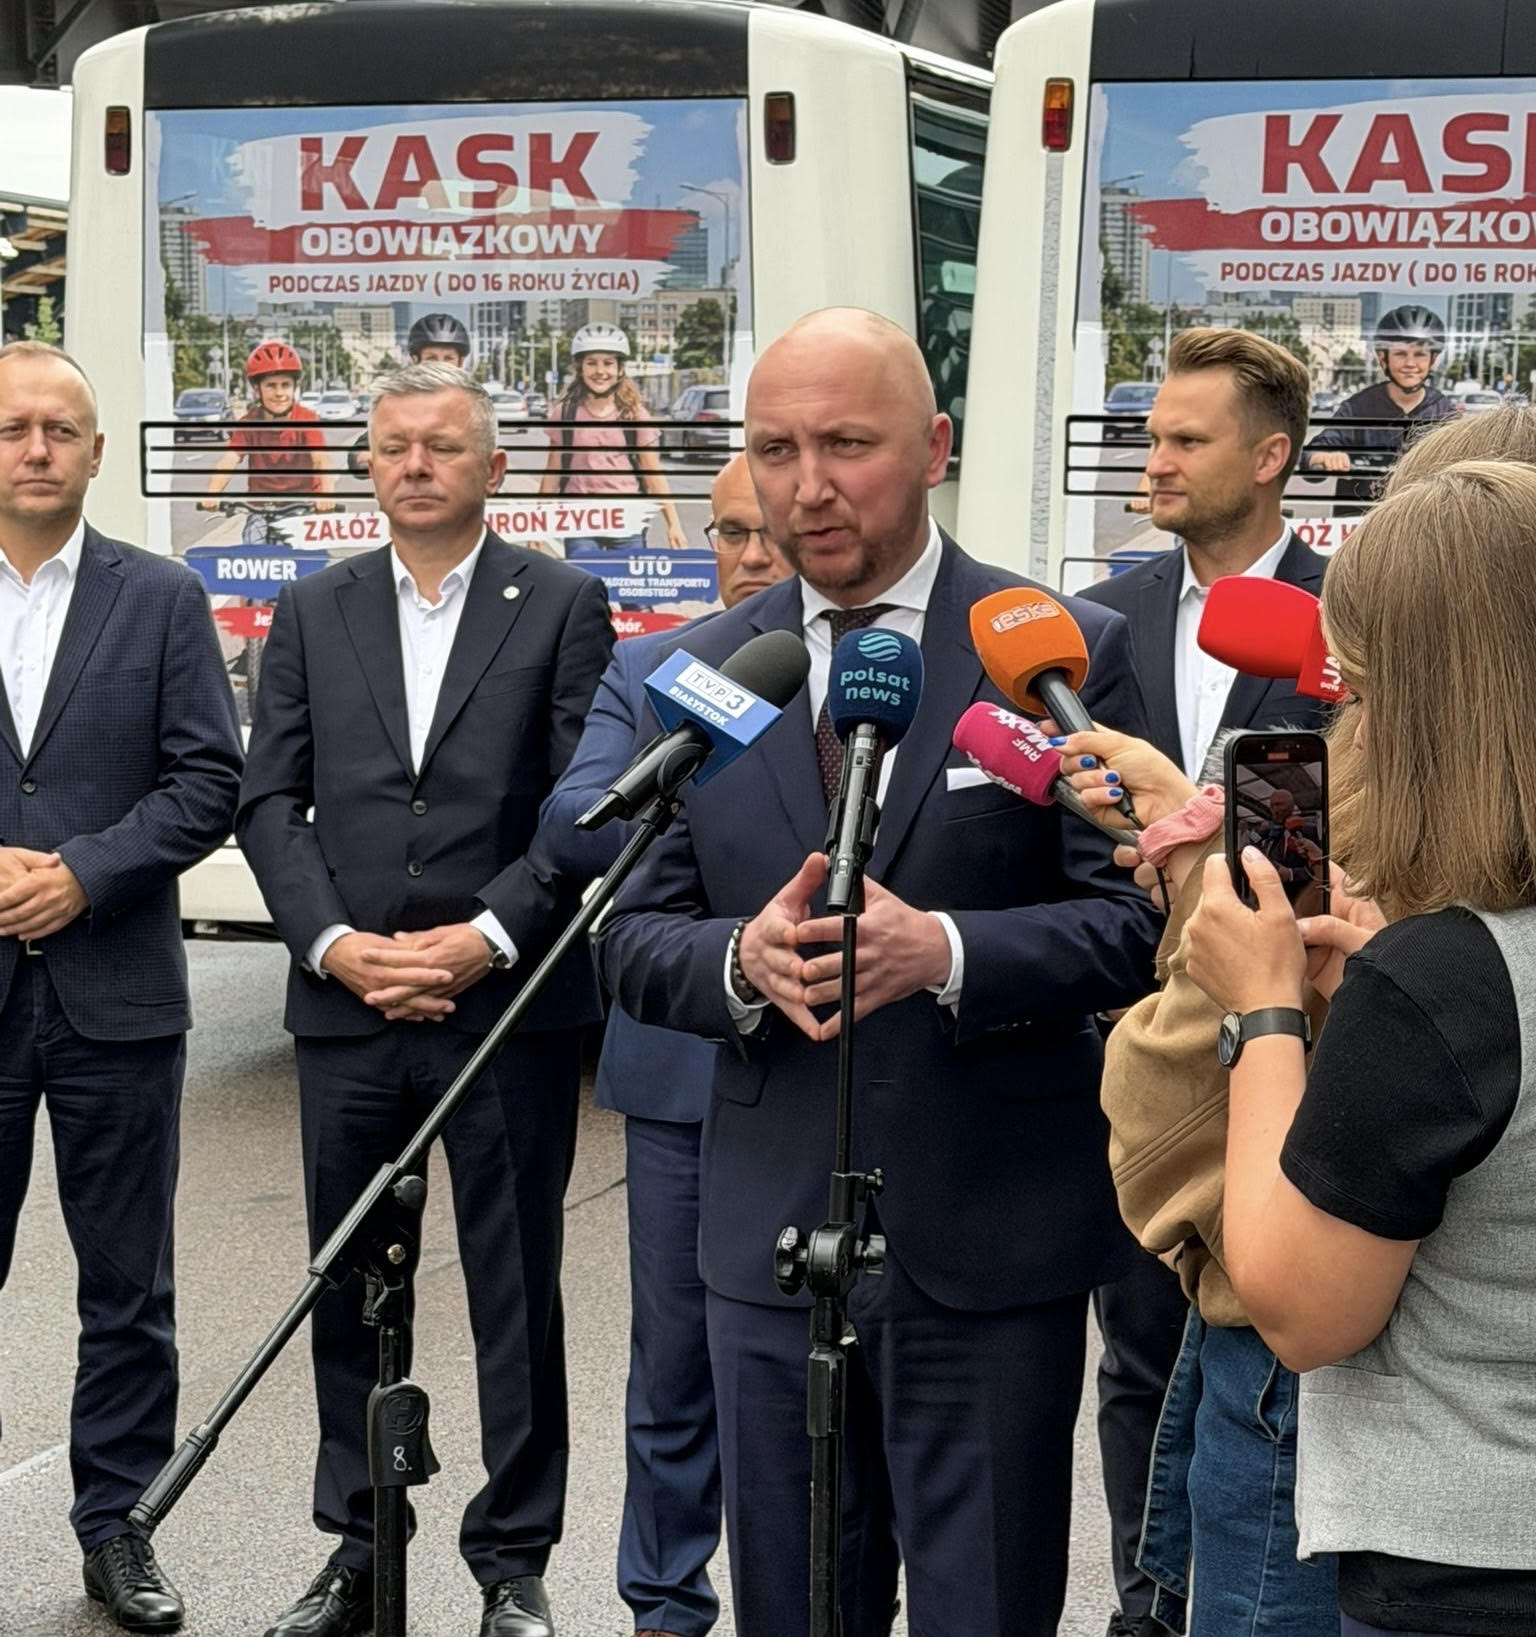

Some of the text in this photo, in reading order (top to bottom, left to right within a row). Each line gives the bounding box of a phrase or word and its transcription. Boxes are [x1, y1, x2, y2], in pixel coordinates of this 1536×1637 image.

[1262, 112, 1536, 194] KAS
[300, 132, 605, 211] KASK
[301, 223, 605, 261] OBOWIĄZKOWY
[1260, 211, 1536, 249] OBOWIĄZKO
[269, 275, 360, 293] PODCZAS
[366, 274, 428, 292] JAZDY
[448, 274, 476, 291] DO
[482, 273, 502, 291] 16
[508, 273, 565, 291] ROKU
[571, 267, 640, 295] ŻYCIA)
[1220, 262, 1324, 282] PODCZAS
[1331, 262, 1402, 282] JAZDY
[1424, 263, 1457, 282] DO
[1464, 263, 1487, 282] 16
[303, 511, 381, 541] ZAŁÓŻ
[554, 505, 625, 531] ŻYCIE
[217, 557, 297, 580] ROWER
[628, 555, 672, 576] UTO
[612, 617, 646, 633] bór.
[840, 667, 911, 691] polsat
[668, 686, 730, 726] BIAŁYSTOK
[845, 686, 902, 706] news
[1011, 738, 1043, 762] RMF
